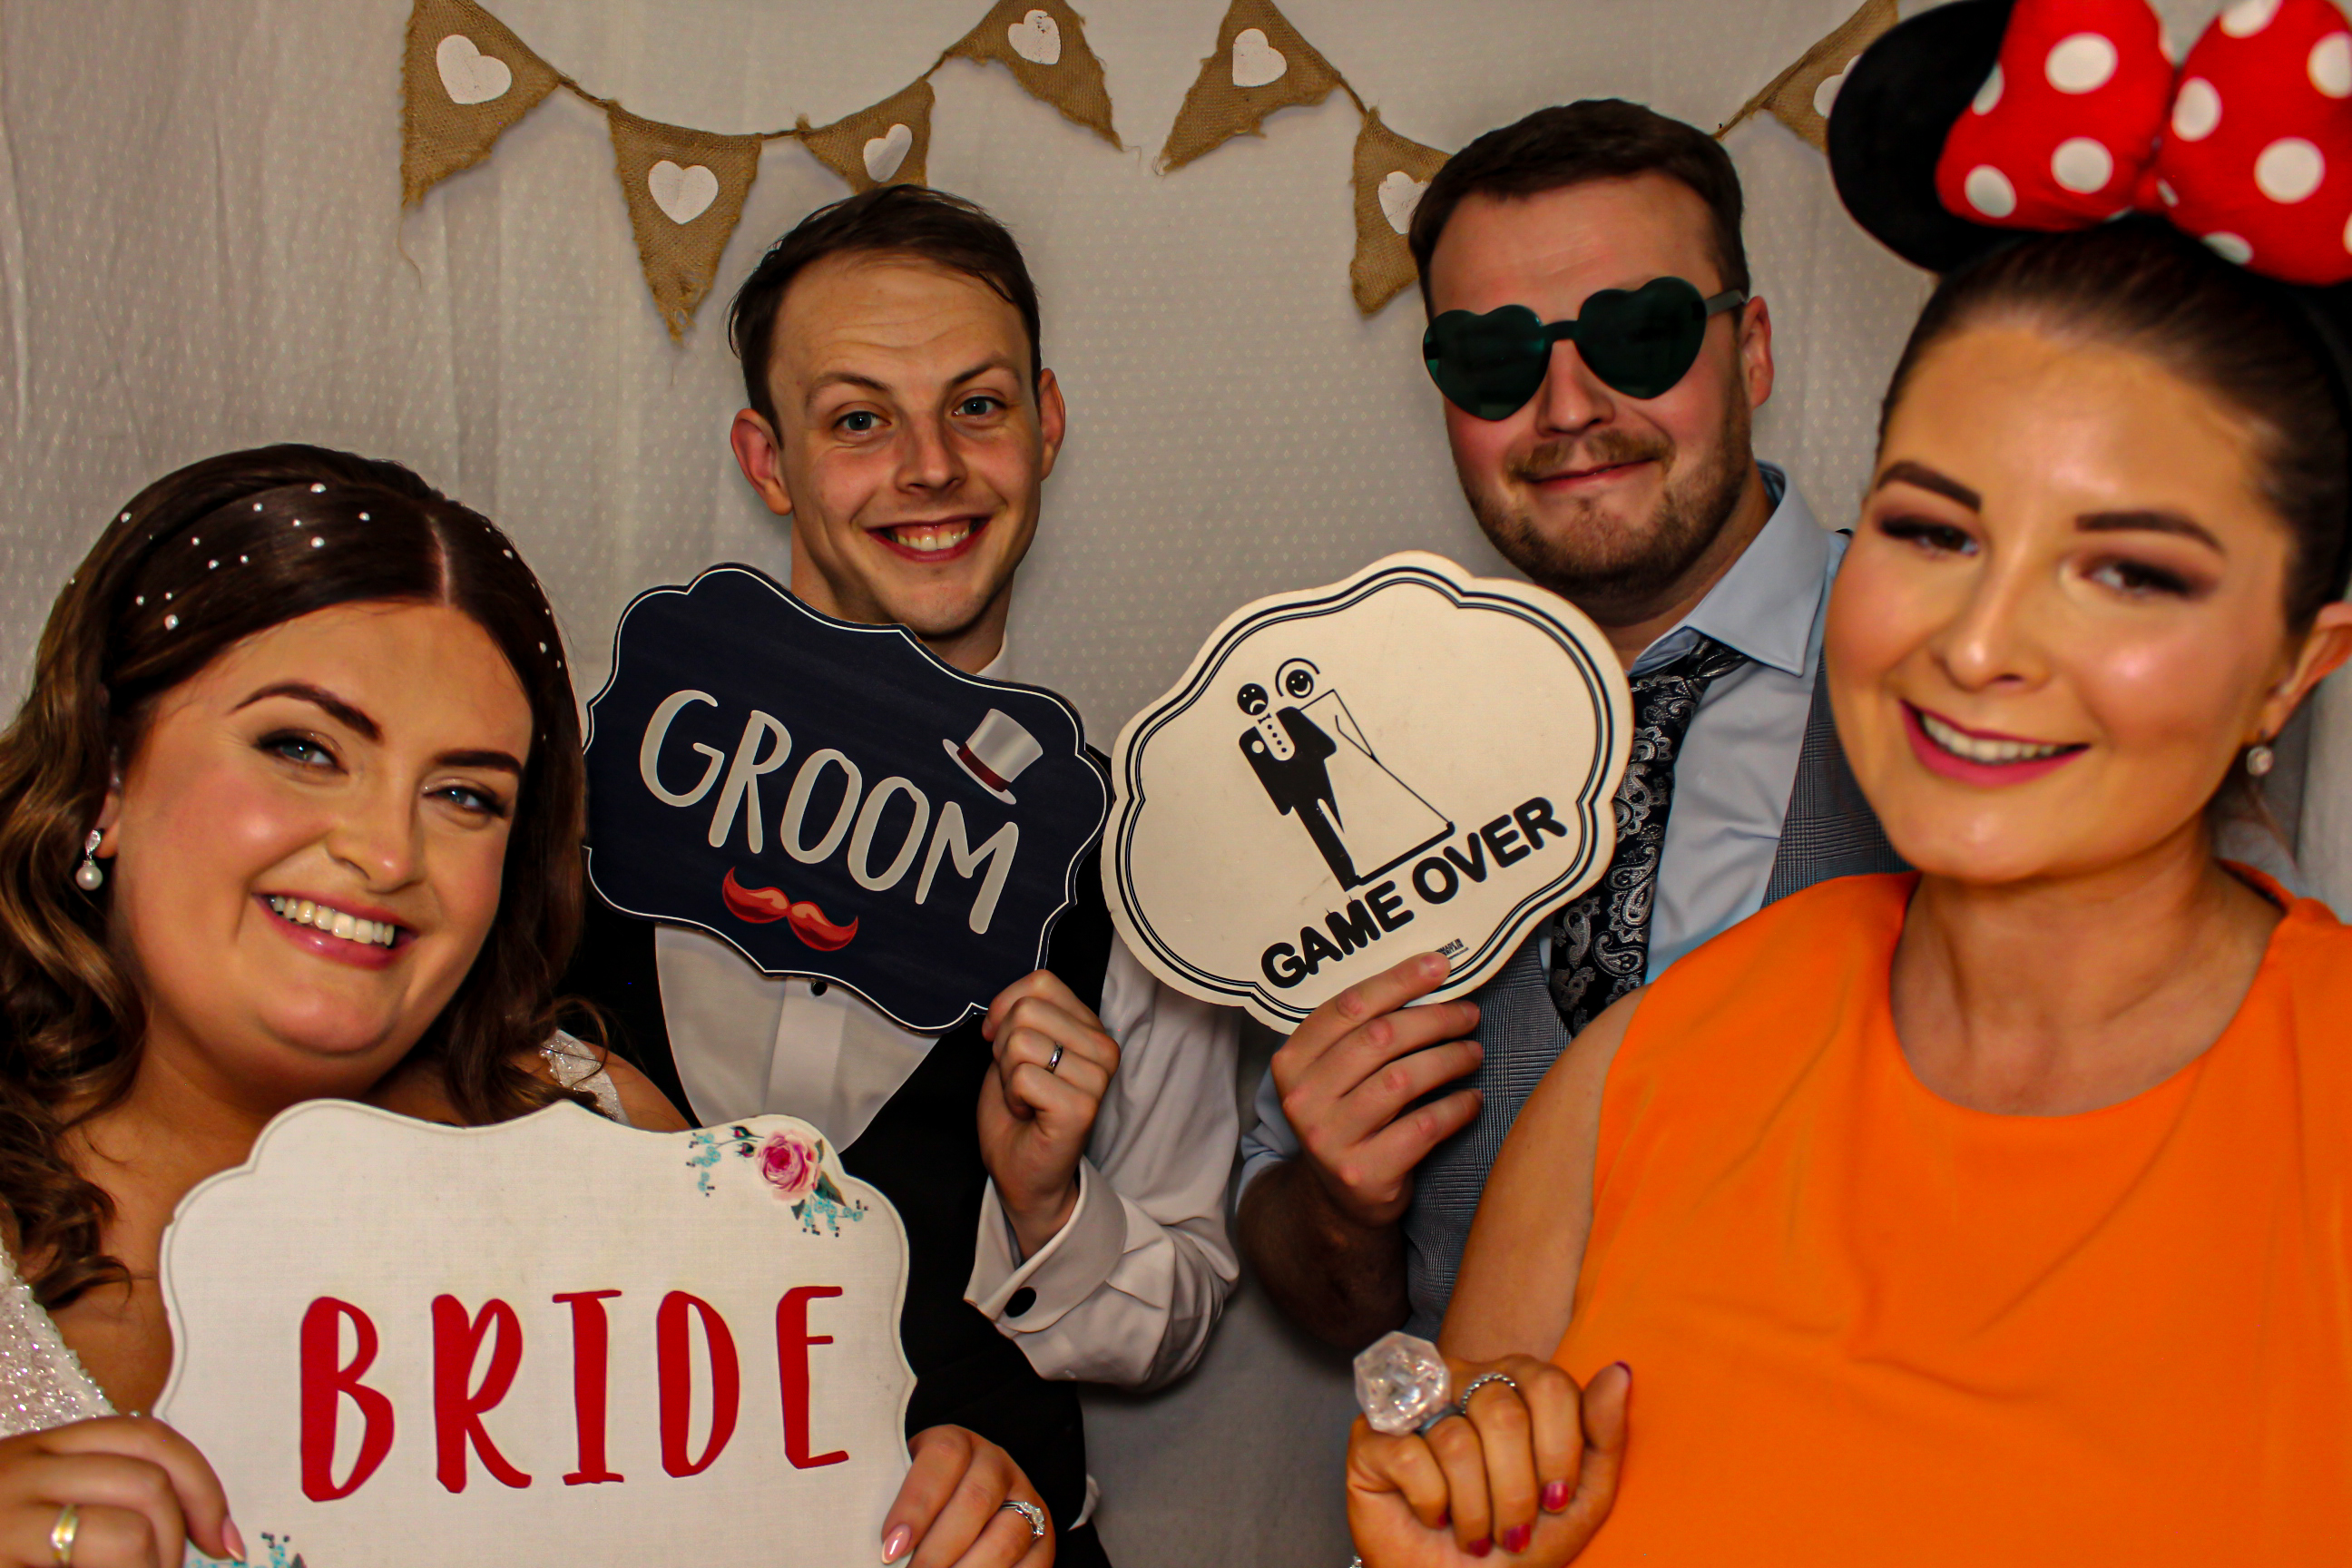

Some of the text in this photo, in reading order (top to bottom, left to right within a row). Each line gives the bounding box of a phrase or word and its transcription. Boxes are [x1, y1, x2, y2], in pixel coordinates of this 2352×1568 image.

[639, 689, 1020, 935] GROOM
[1260, 797, 1568, 989] GAME OVER
[300, 1285, 849, 1503] BRIDE
